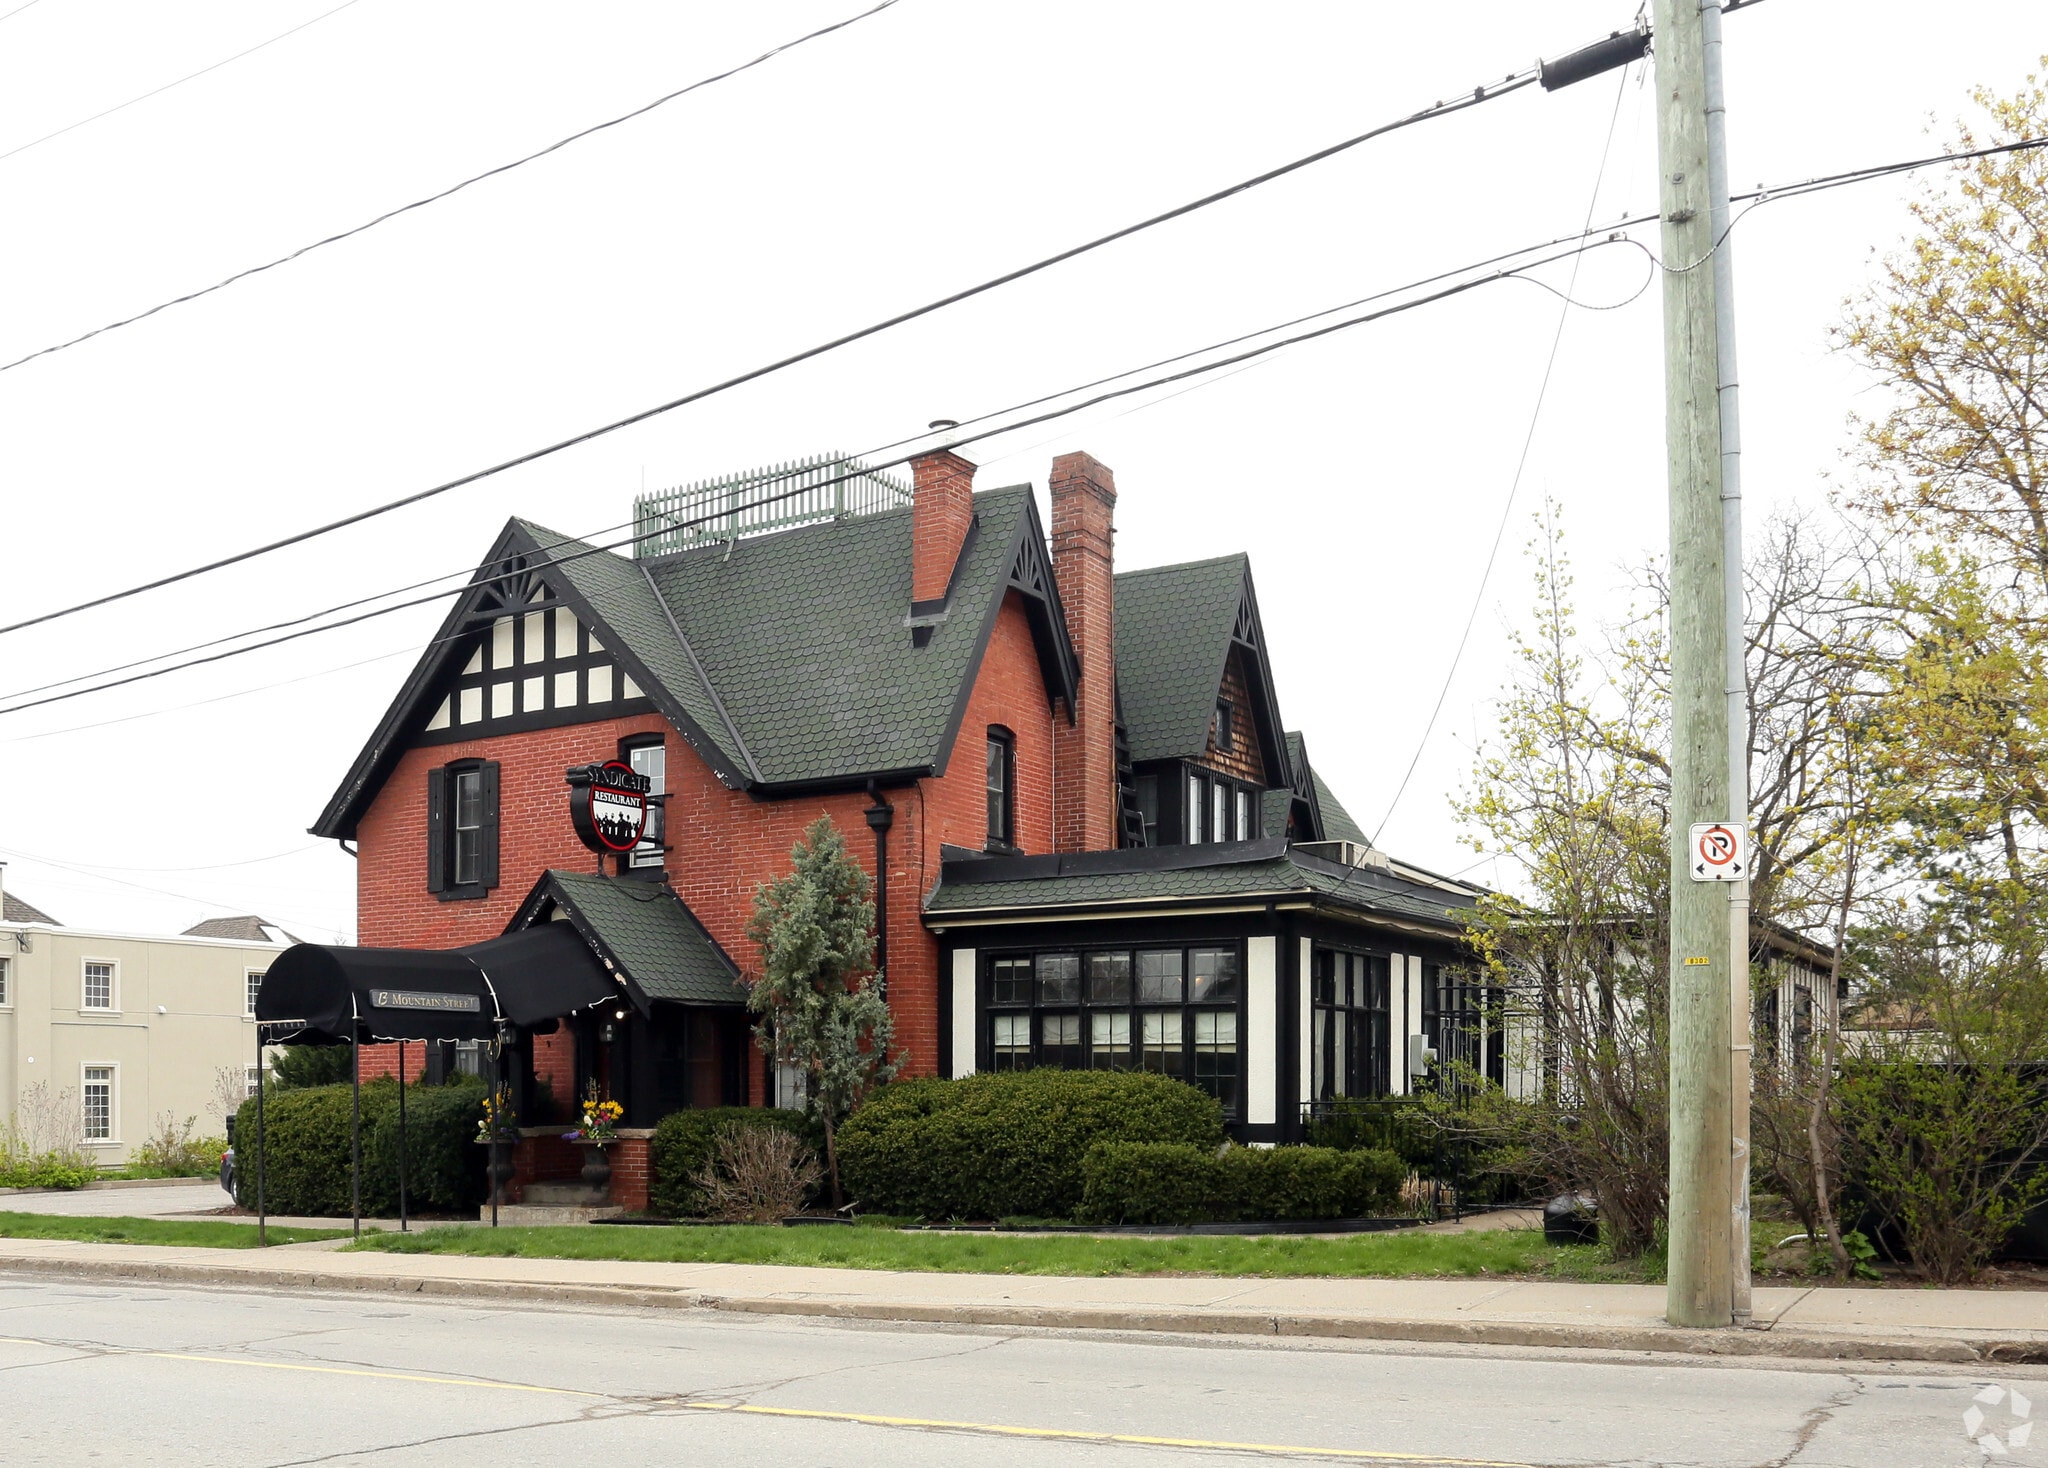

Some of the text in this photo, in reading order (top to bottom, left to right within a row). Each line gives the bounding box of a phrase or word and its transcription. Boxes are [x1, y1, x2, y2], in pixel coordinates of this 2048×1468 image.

[588, 768, 650, 791] SYNDICATE
[594, 790, 641, 807] RESTAURANT
[1712, 836, 1728, 857] P
[392, 993, 441, 1007] MOUNTAIN
[443, 996, 475, 1008] STREET
